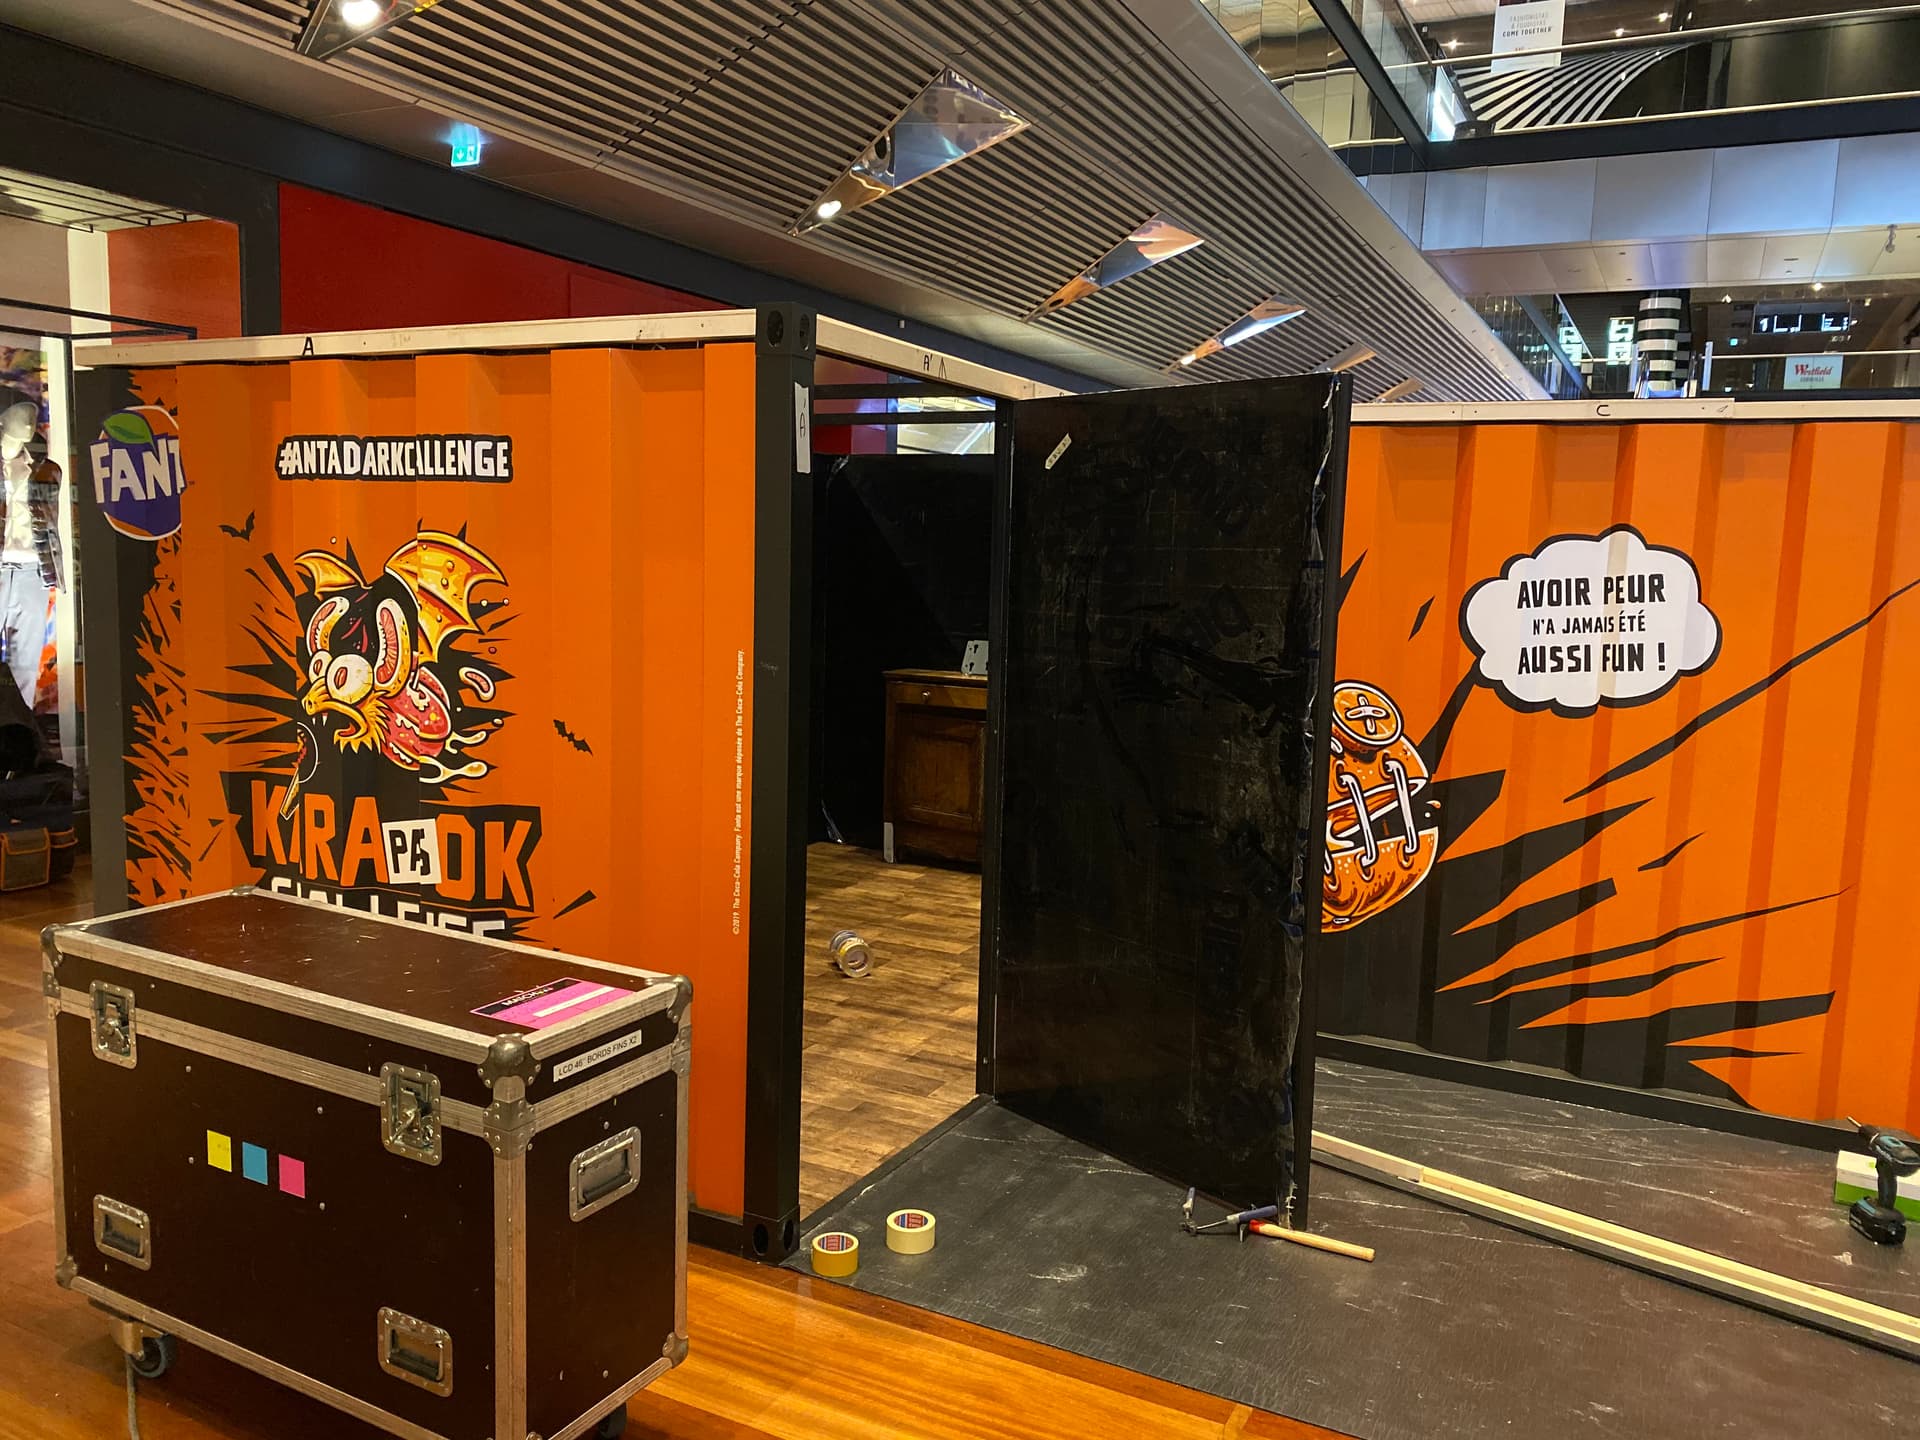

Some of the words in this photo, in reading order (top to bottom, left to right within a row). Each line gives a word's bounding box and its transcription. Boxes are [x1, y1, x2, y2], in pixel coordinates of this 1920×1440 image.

[1521, 26, 1553, 36] TOGETHER
[302, 336, 315, 356] A
[1794, 364, 1834, 376] Westfield
[1596, 404, 1611, 417] C
[1517, 577, 1591, 609] AVOIR
[1603, 573, 1666, 605] PEUR
[1533, 618, 1555, 635] N'A
[1562, 616, 1614, 634] JAMAIS
[1618, 610, 1646, 632] ÉTÉ
[1517, 644, 1591, 675] AUSSI
[1601, 643, 1644, 673] FUN
[1657, 642, 1666, 671] !
[735, 681, 743, 714] Coca-Cola
[735, 715, 743, 726] The
[735, 728, 743, 736] de
[735, 738, 744, 764] déposée
[735, 766, 744, 789] marque
[734, 815, 742, 832] Fanta
[733, 865, 741, 896] Coca-Cola
[732, 898, 740, 909] The
[558, 1063, 574, 1076] LCD
[587, 1046, 612, 1064] BORDS
[612, 1040, 628, 1053] FINS
